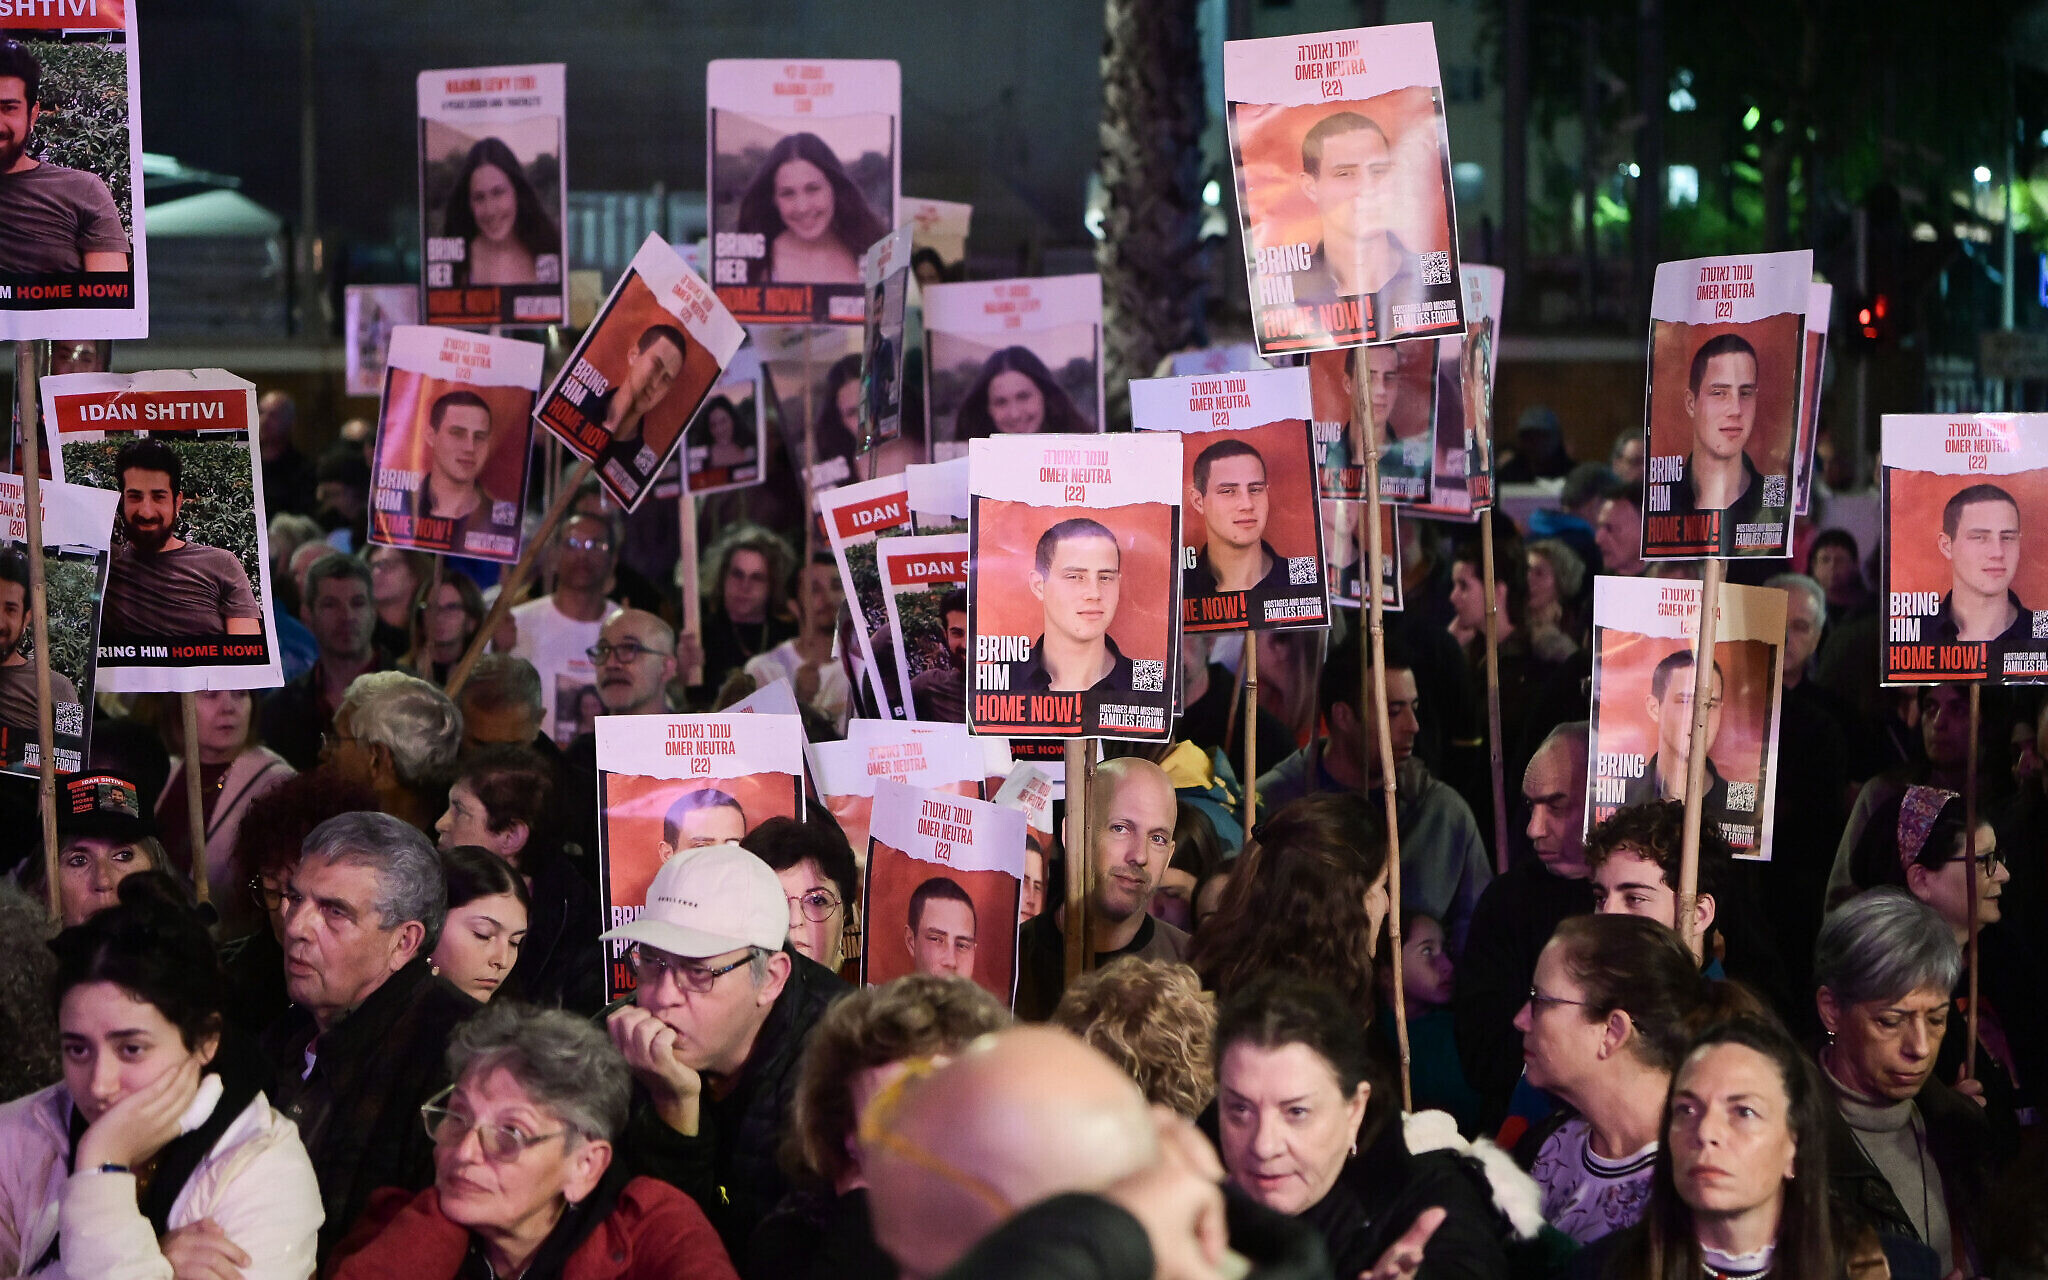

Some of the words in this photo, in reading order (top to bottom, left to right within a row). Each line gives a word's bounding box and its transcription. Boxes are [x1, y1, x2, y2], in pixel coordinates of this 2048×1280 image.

[0, 0, 97, 16] SHTIVI
[1298, 43, 1333, 62] נאוטרה
[1295, 62, 1324, 81] OMER
[1326, 58, 1367, 79] NEUTRA
[1321, 78, 1343, 99] (22)
[1255, 242, 1312, 275] BRING
[1700, 265, 1730, 283] נאוטרה
[1732, 264, 1753, 281] עומר
[17, 285, 73, 299] HOME
[79, 284, 128, 298] NOW!
[1259, 274, 1295, 306] HIM
[1696, 284, 1719, 301] OMER
[1721, 282, 1755, 300] NEUTRA
[1261, 306, 1316, 339] HOME
[1318, 295, 1375, 333] NOW!
[1431, 309, 1458, 326] FORUM
[1715, 301, 1733, 319] (22)
[571, 357, 609, 398] BRING
[1225, 379, 1246, 394] עומר
[560, 375, 589, 407] HIM
[1191, 381, 1222, 397] נאוטרה
[80, 403, 137, 422] IDAN
[144, 401, 225, 420] SHTIVI
[1189, 396, 1214, 412] OMER
[1215, 394, 1251, 410] NEUTRA
[1211, 411, 1230, 428] (22)
[1315, 421, 1342, 443] RING
[1948, 423, 1983, 437] נאוטרה
[1945, 439, 1972, 453] OMER
[1974, 439, 2010, 453] NEUTRA
[1043, 450, 1081, 466] נאוטרה
[1085, 450, 1109, 466] עומר
[1968, 455, 1988, 471] (22)
[1039, 467, 1069, 483] OMER
[1071, 468, 1112, 484] NEUTRA
[1650, 455, 1684, 484] BRING
[377, 468, 421, 492] BRING
[375, 489, 403, 511] HIM
[1064, 484, 1085, 503] (22)
[1649, 485, 1671, 512] HIM
[851, 503, 900, 527] IDAN
[9, 519, 25, 538] (28)
[1648, 515, 1681, 543] HOME
[906, 561, 955, 577] IDAN
[1263, 598, 1289, 608] HOSTAGES
[1289, 598, 1299, 607] AND
[1299, 596, 1321, 606] MISSING
[1661, 587, 1695, 602] נאוטרה
[1202, 591, 1248, 622] NOW!
[1264, 606, 1297, 620] FAMILIES
[1296, 604, 1322, 618] FORUM
[1658, 602, 1684, 617] OMER
[1889, 591, 1940, 617] BRING
[1889, 617, 1921, 642] HIM
[97, 645, 136, 658] RING
[140, 645, 169, 658] HIM
[172, 645, 218, 658] HOME
[223, 644, 264, 657] NOW!
[976, 634, 1031, 664] BRING
[1889, 645, 1935, 670] HOME
[1939, 642, 1988, 670] NOW!
[2003, 660, 2035, 673] FAMILIES
[975, 663, 1010, 691] HIM
[975, 693, 1027, 722] HOME
[1031, 691, 1083, 724] NOW!
[1099, 703, 1128, 714] HOSTAGES
[1128, 705, 1139, 715] AND
[1139, 706, 1164, 717] MISSING
[1099, 712, 1135, 728] FAMILIES
[1135, 714, 1164, 730] FORUM
[667, 723, 704, 739] נאוטרה
[707, 723, 731, 738] עומר
[665, 740, 693, 756] OMER
[696, 740, 736, 755] NEUTRA
[1038, 744, 1065, 755] NOW
[55, 758, 81, 773] FORUM
[690, 757, 711, 774] (22)
[866, 761, 892, 777] OMER
[894, 758, 928, 773] NEUTRA
[1597, 752, 1645, 779] BRING
[1595, 777, 1626, 804] HIM
[921, 800, 952, 818] נאוטרה
[953, 805, 973, 826] עומר
[917, 818, 941, 837] OMER
[941, 823, 974, 846] NEUTRA
[1728, 831, 1754, 846] FORUM
[934, 843, 951, 862] (22)
[613, 963, 638, 989] HO
